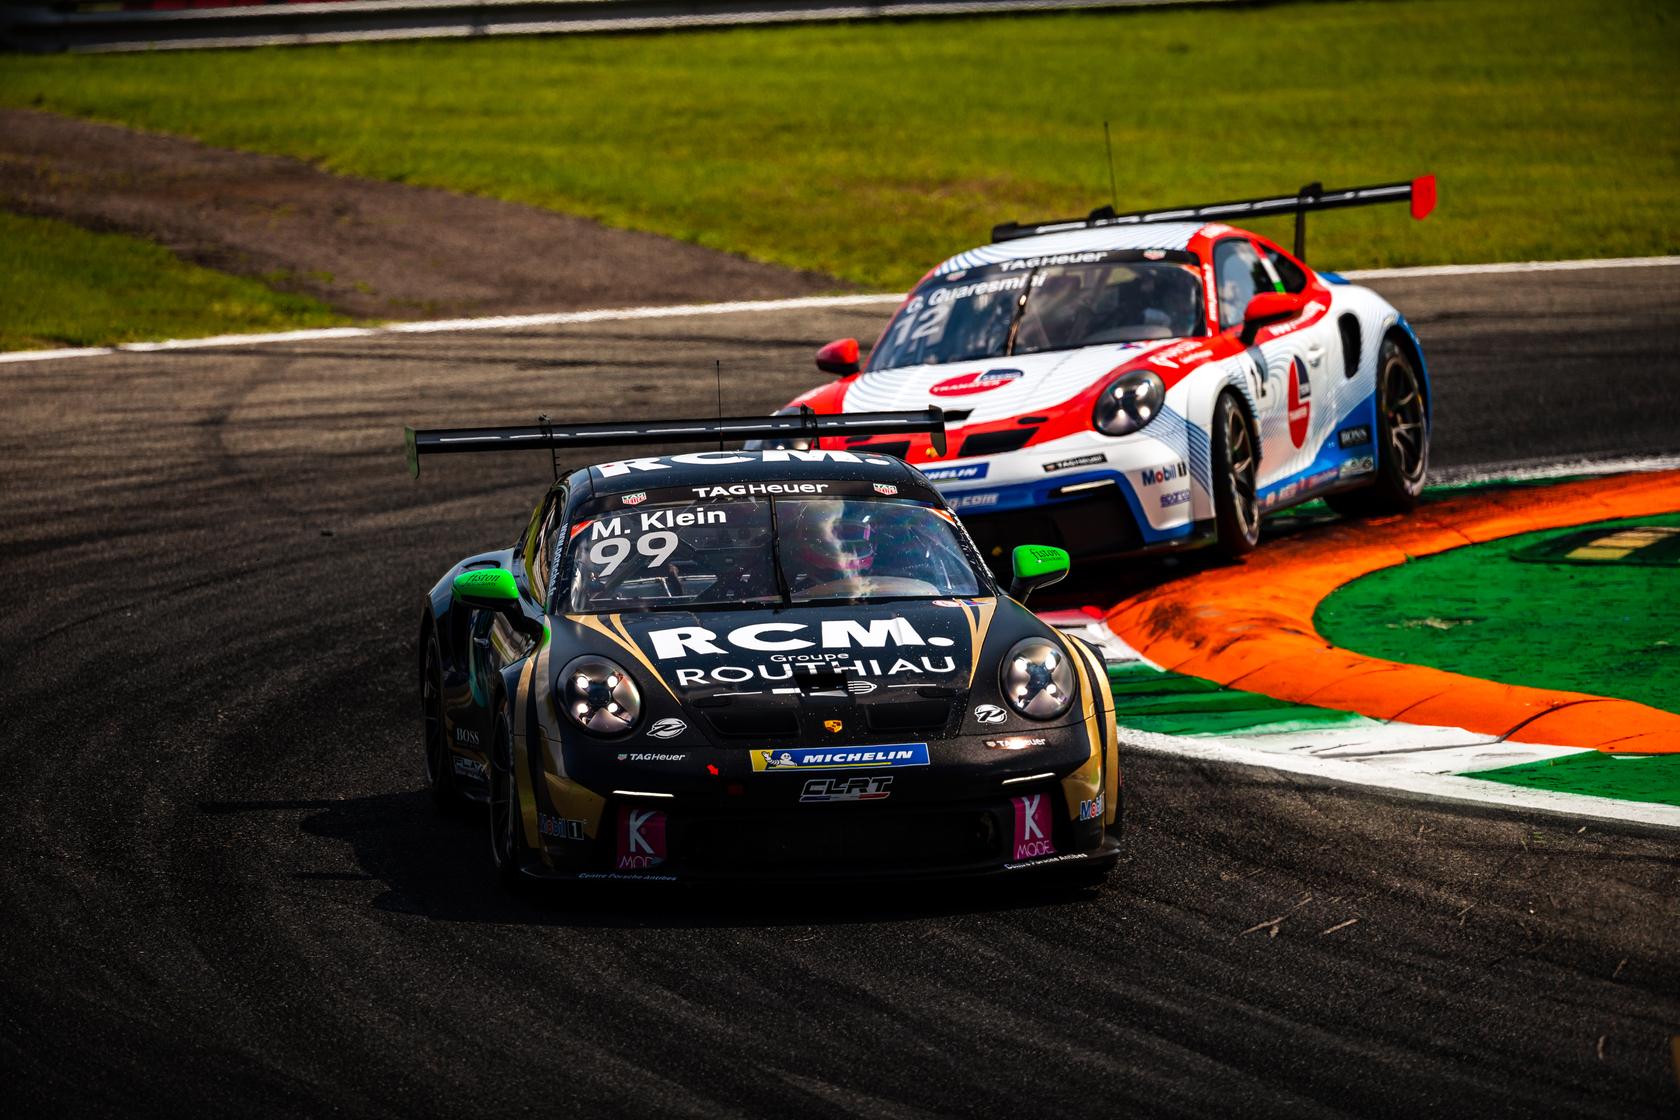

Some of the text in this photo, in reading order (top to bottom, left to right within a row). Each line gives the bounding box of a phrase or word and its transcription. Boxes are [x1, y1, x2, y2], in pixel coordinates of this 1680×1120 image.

[894, 307, 946, 348] 12
[596, 449, 890, 478] RCM.
[591, 508, 727, 541] M. Klein
[590, 531, 678, 577] 99
[648, 617, 954, 660] RCM.
[676, 656, 956, 686] ROUTHIAU
[771, 653, 849, 664] Groupe
[456, 727, 480, 745] BOSS
[802, 750, 914, 764] MICHELIN
[629, 809, 657, 854] K
[1021, 794, 1044, 841] K
[1017, 840, 1055, 859] MODE
